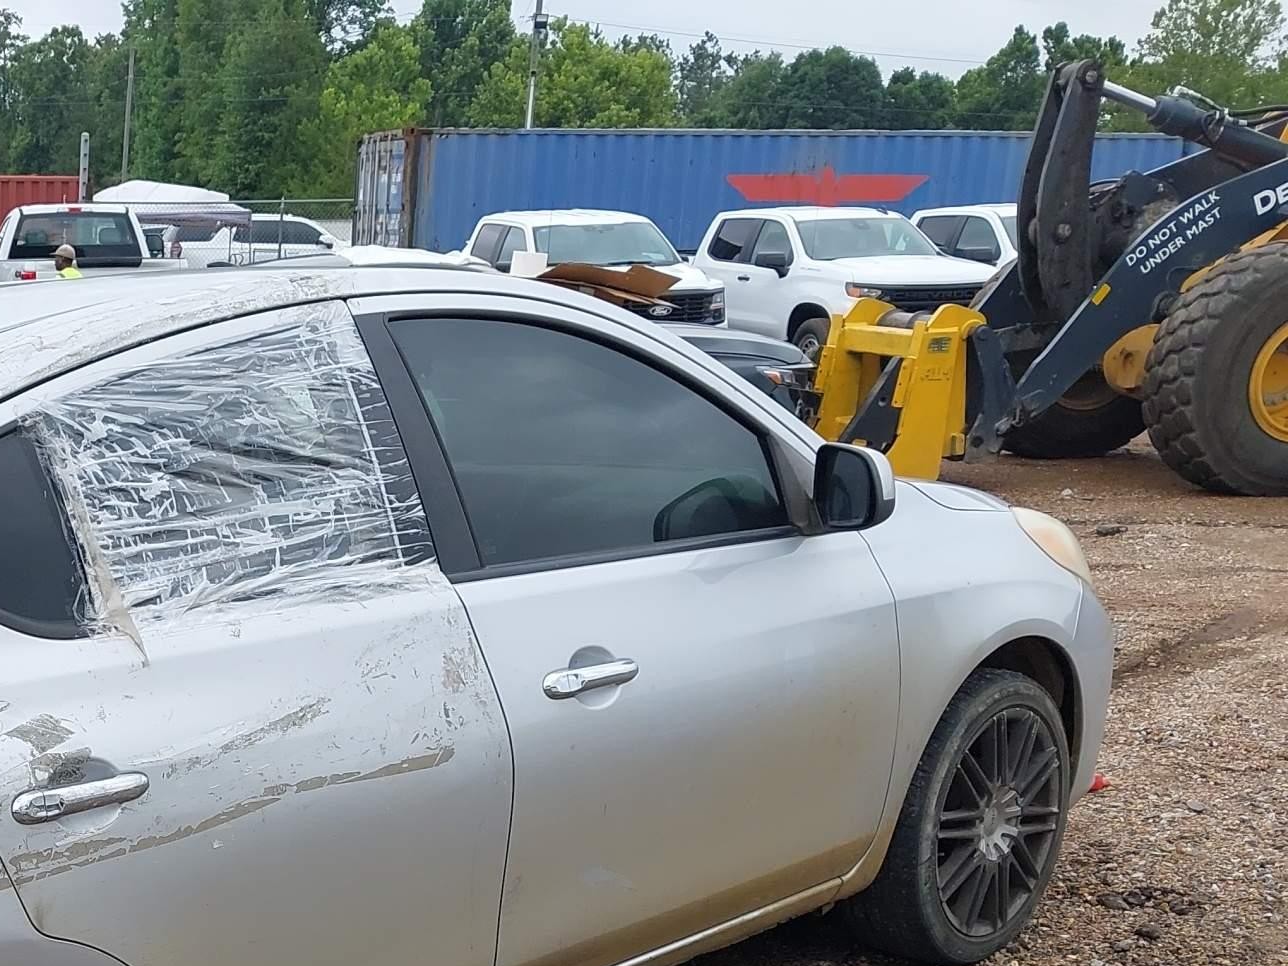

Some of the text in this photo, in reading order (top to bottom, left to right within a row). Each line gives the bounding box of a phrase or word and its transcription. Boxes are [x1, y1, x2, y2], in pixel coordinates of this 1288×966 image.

[1125, 190, 1222, 267] DO NOT WALK
[1253, 182, 1288, 216] DE
[1140, 207, 1222, 274] UNDER MAST
